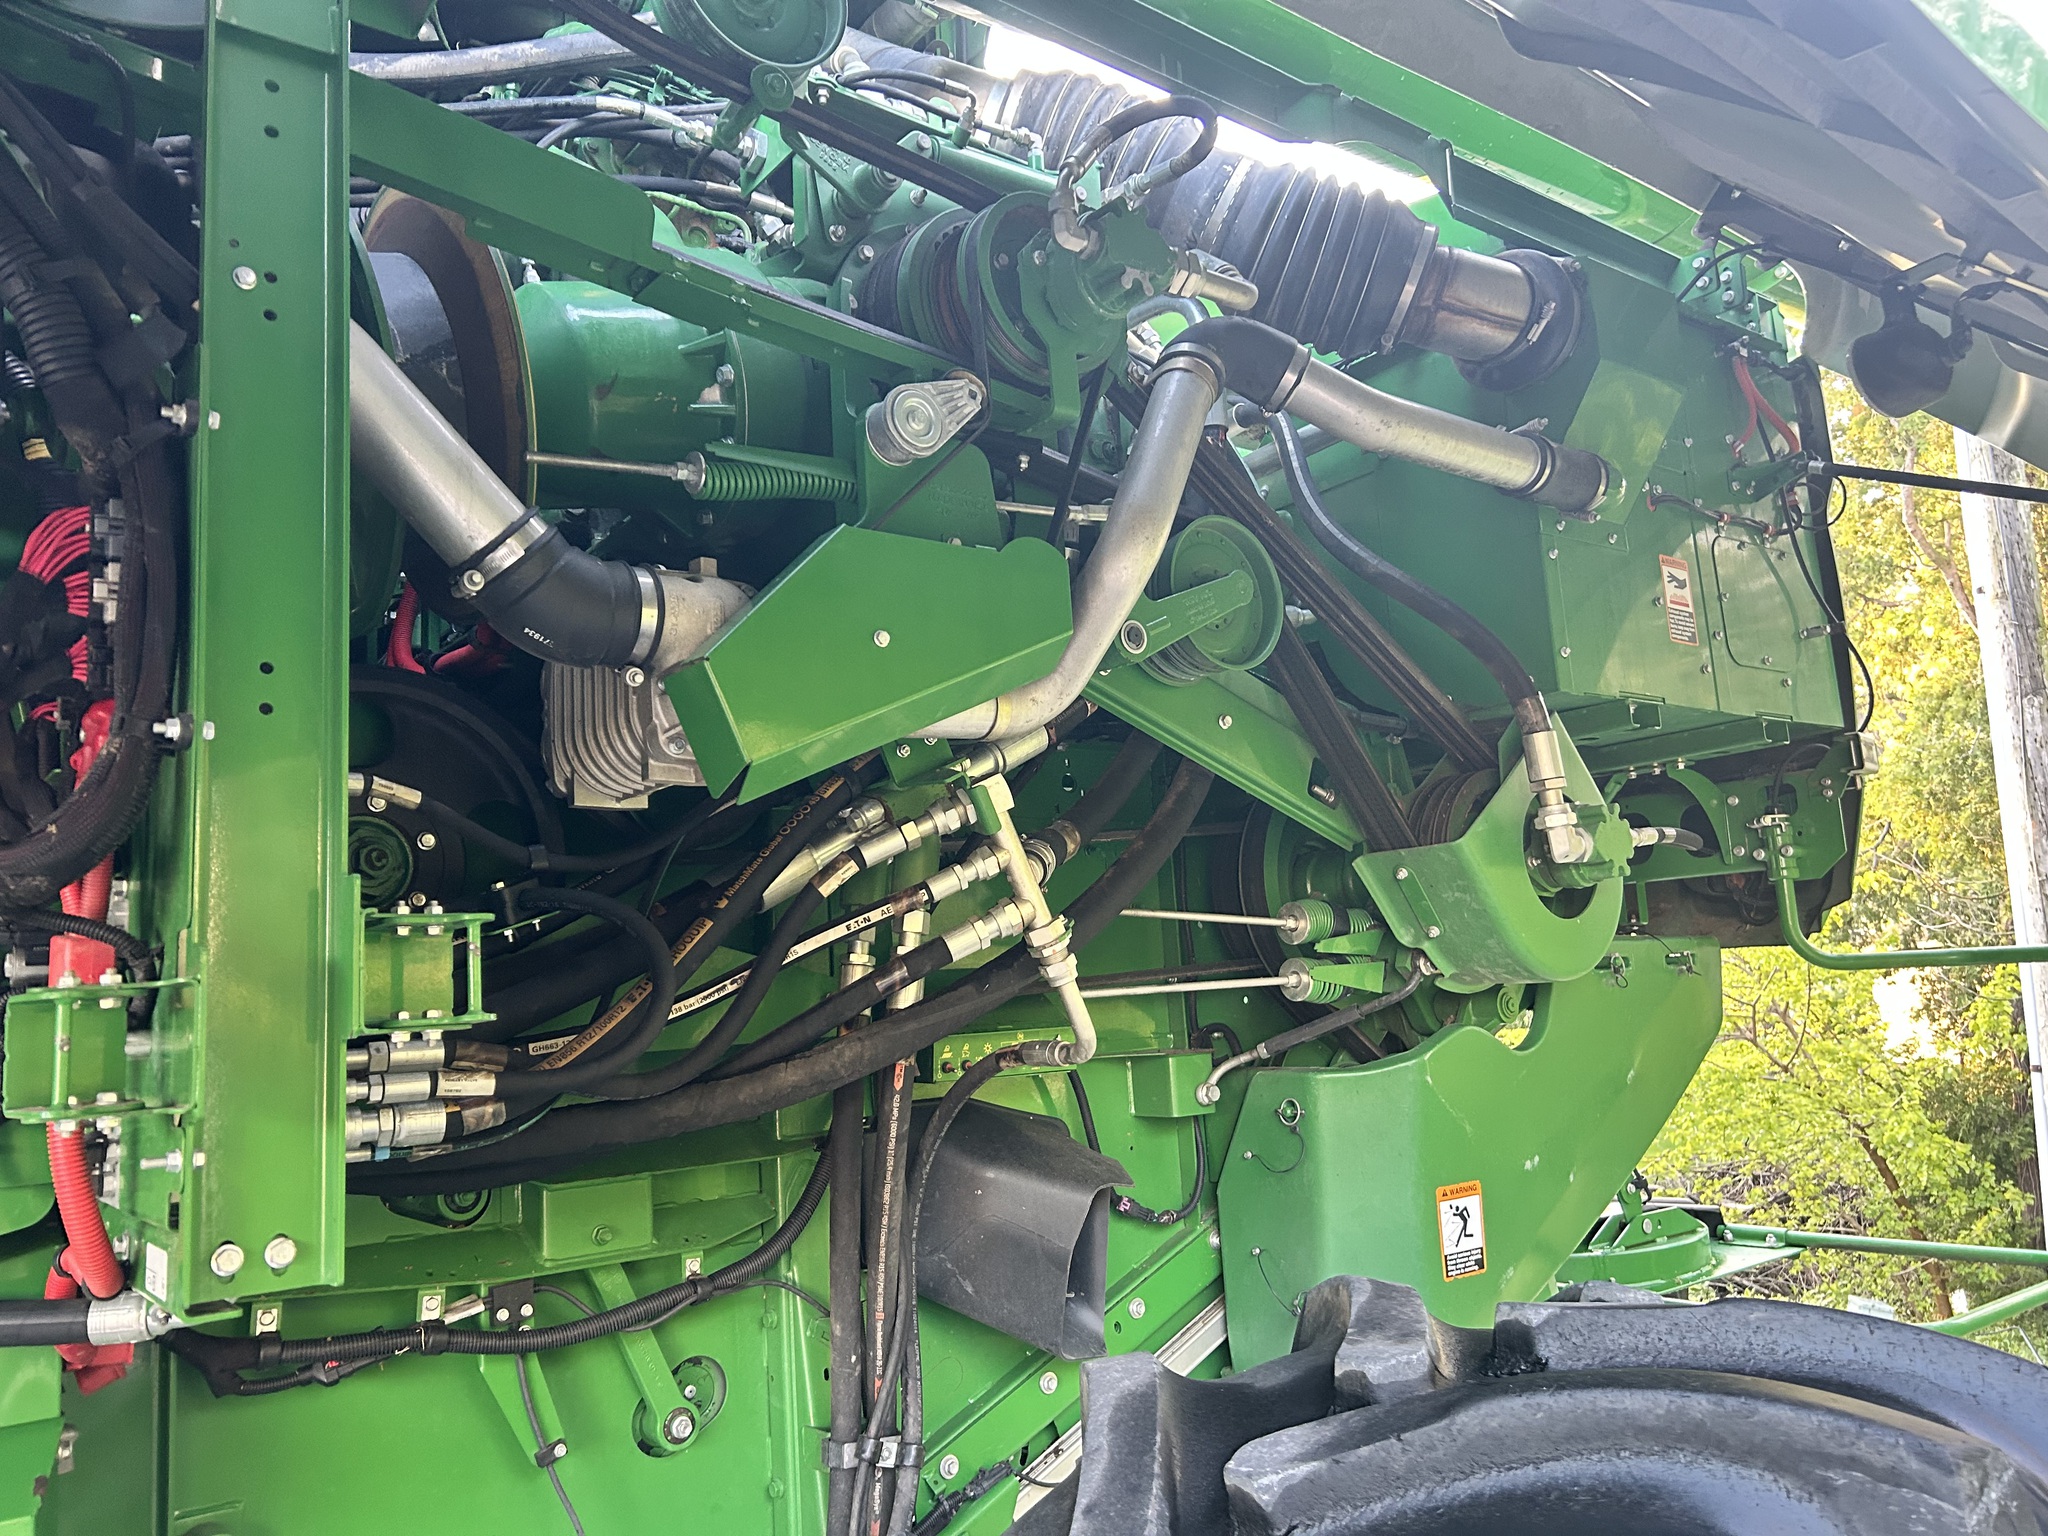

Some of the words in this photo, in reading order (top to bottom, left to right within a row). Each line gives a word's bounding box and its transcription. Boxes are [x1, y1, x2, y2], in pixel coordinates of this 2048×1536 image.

[760, 834, 783, 858] Global
[684, 1000, 696, 1010] bar
[547, 1044, 576, 1068] EN856
[576, 1005, 627, 1046] R12/100R12
[1450, 1184, 1477, 1196] WARNING
